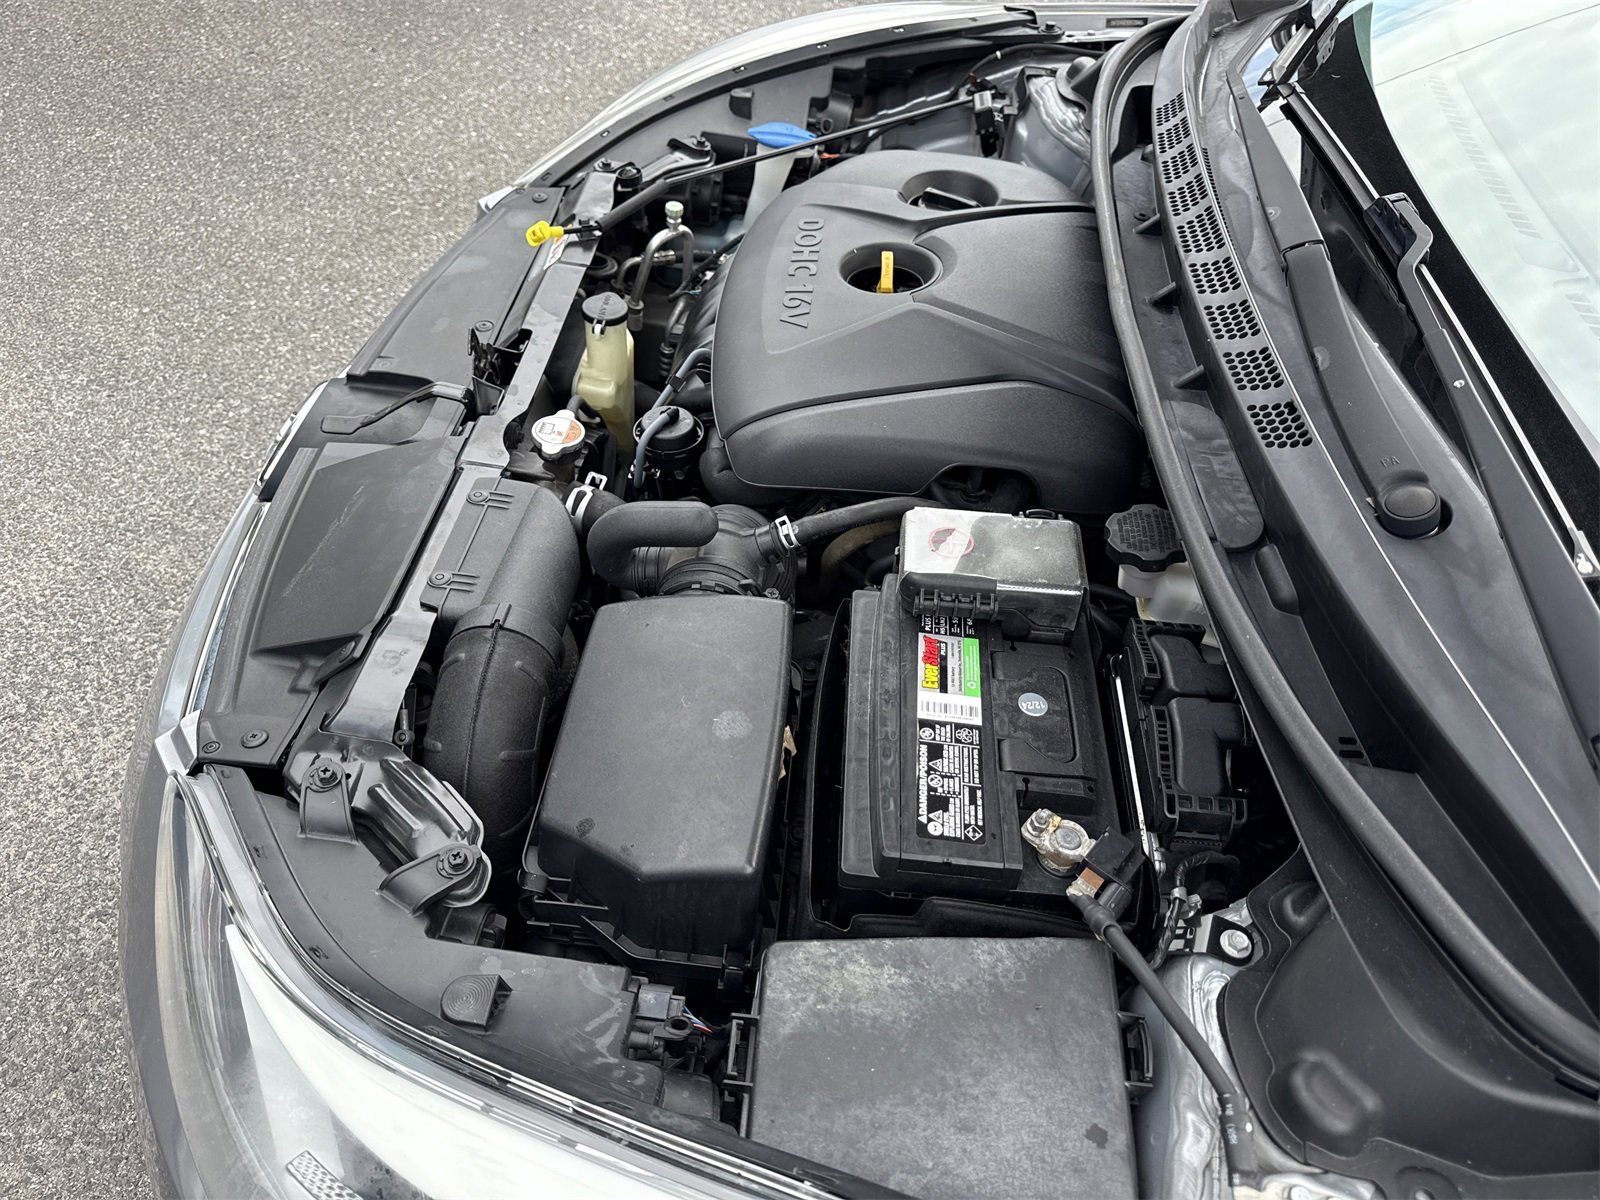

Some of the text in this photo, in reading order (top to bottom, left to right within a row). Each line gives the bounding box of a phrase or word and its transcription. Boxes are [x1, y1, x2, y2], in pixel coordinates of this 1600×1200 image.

[779, 218, 825, 330] DOHC 16V
[924, 617, 932, 631] PLUS
[920, 635, 940, 690] EverStart
[939, 642, 947, 656] PLUS
[1021, 700, 1046, 710] 12/24
[918, 744, 928, 816] DANGER/POISON
